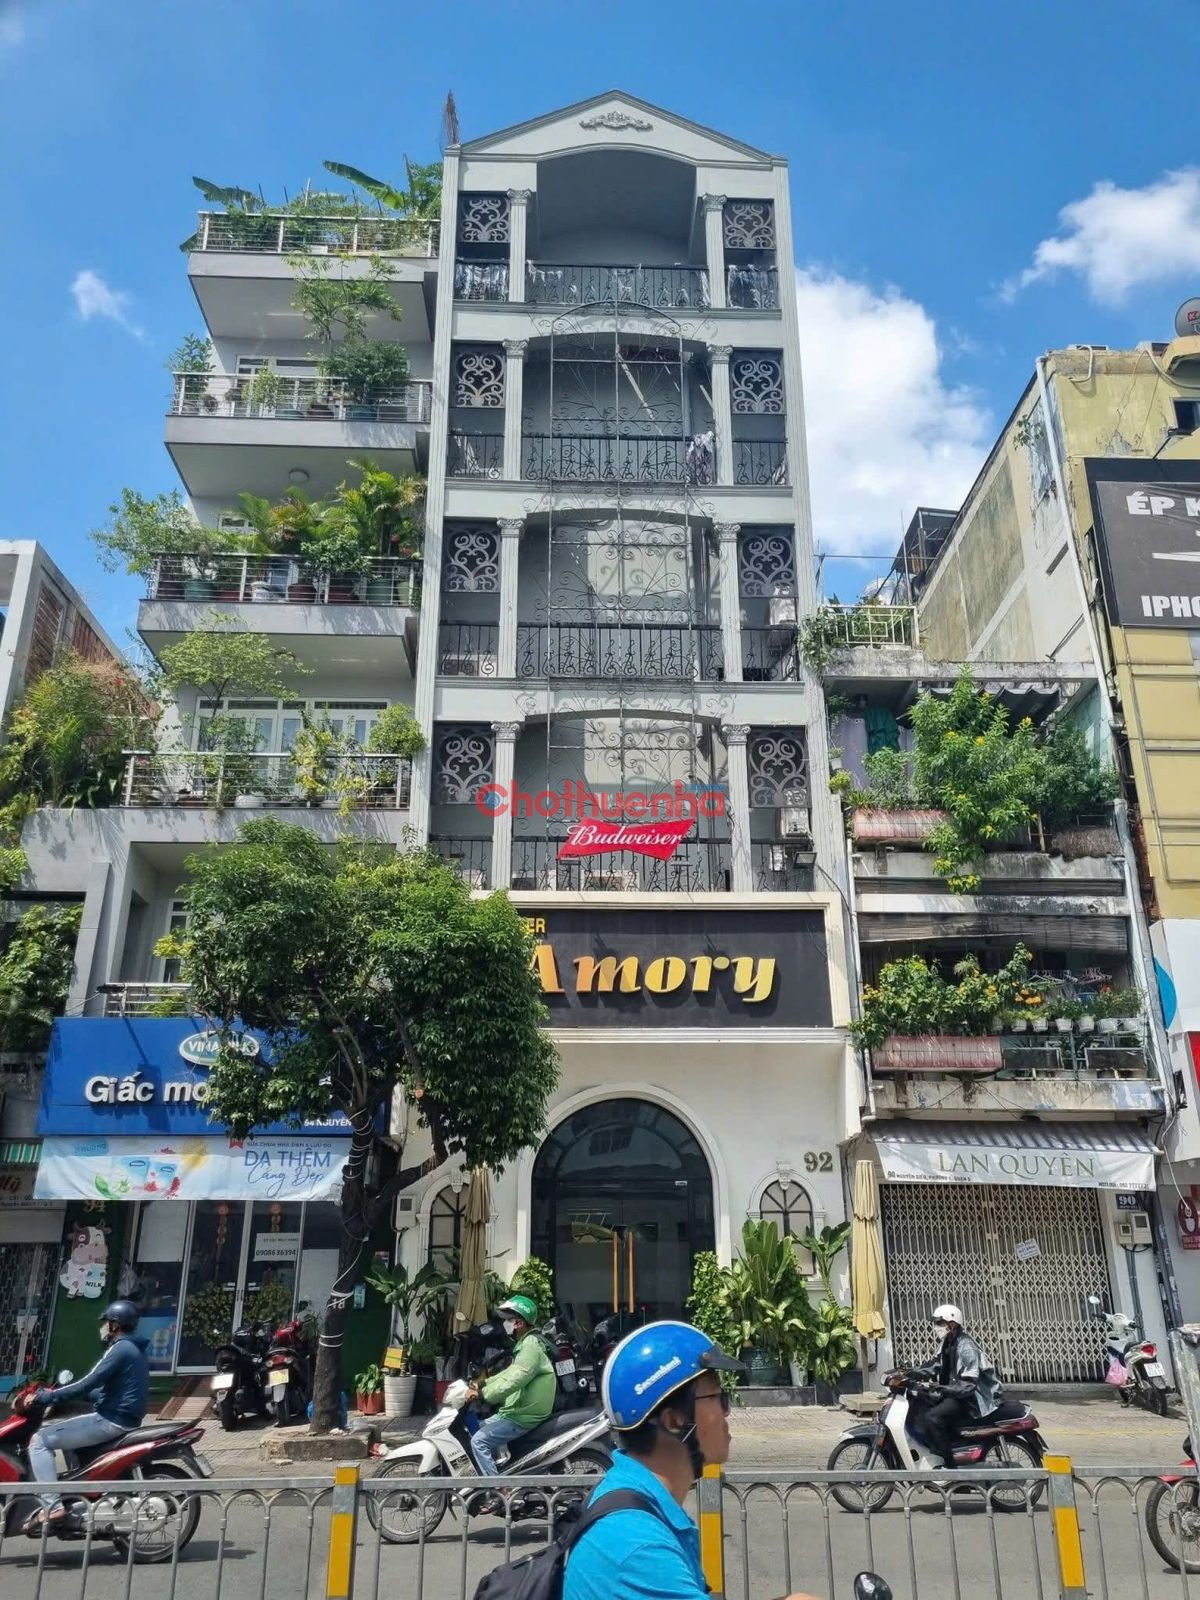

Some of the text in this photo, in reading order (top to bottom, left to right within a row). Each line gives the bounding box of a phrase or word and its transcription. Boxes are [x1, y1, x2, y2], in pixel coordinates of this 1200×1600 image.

[1126, 491, 1175, 515] ÉP
[567, 825, 683, 846] Budweiser
[529, 944, 776, 1003] Amory
[85, 1071, 154, 1104] Giấc
[278, 1148, 331, 1168] THÊM
[804, 1151, 833, 1172] 92
[938, 1152, 990, 1173] LAN
[1118, 1195, 1136, 1205] 90
